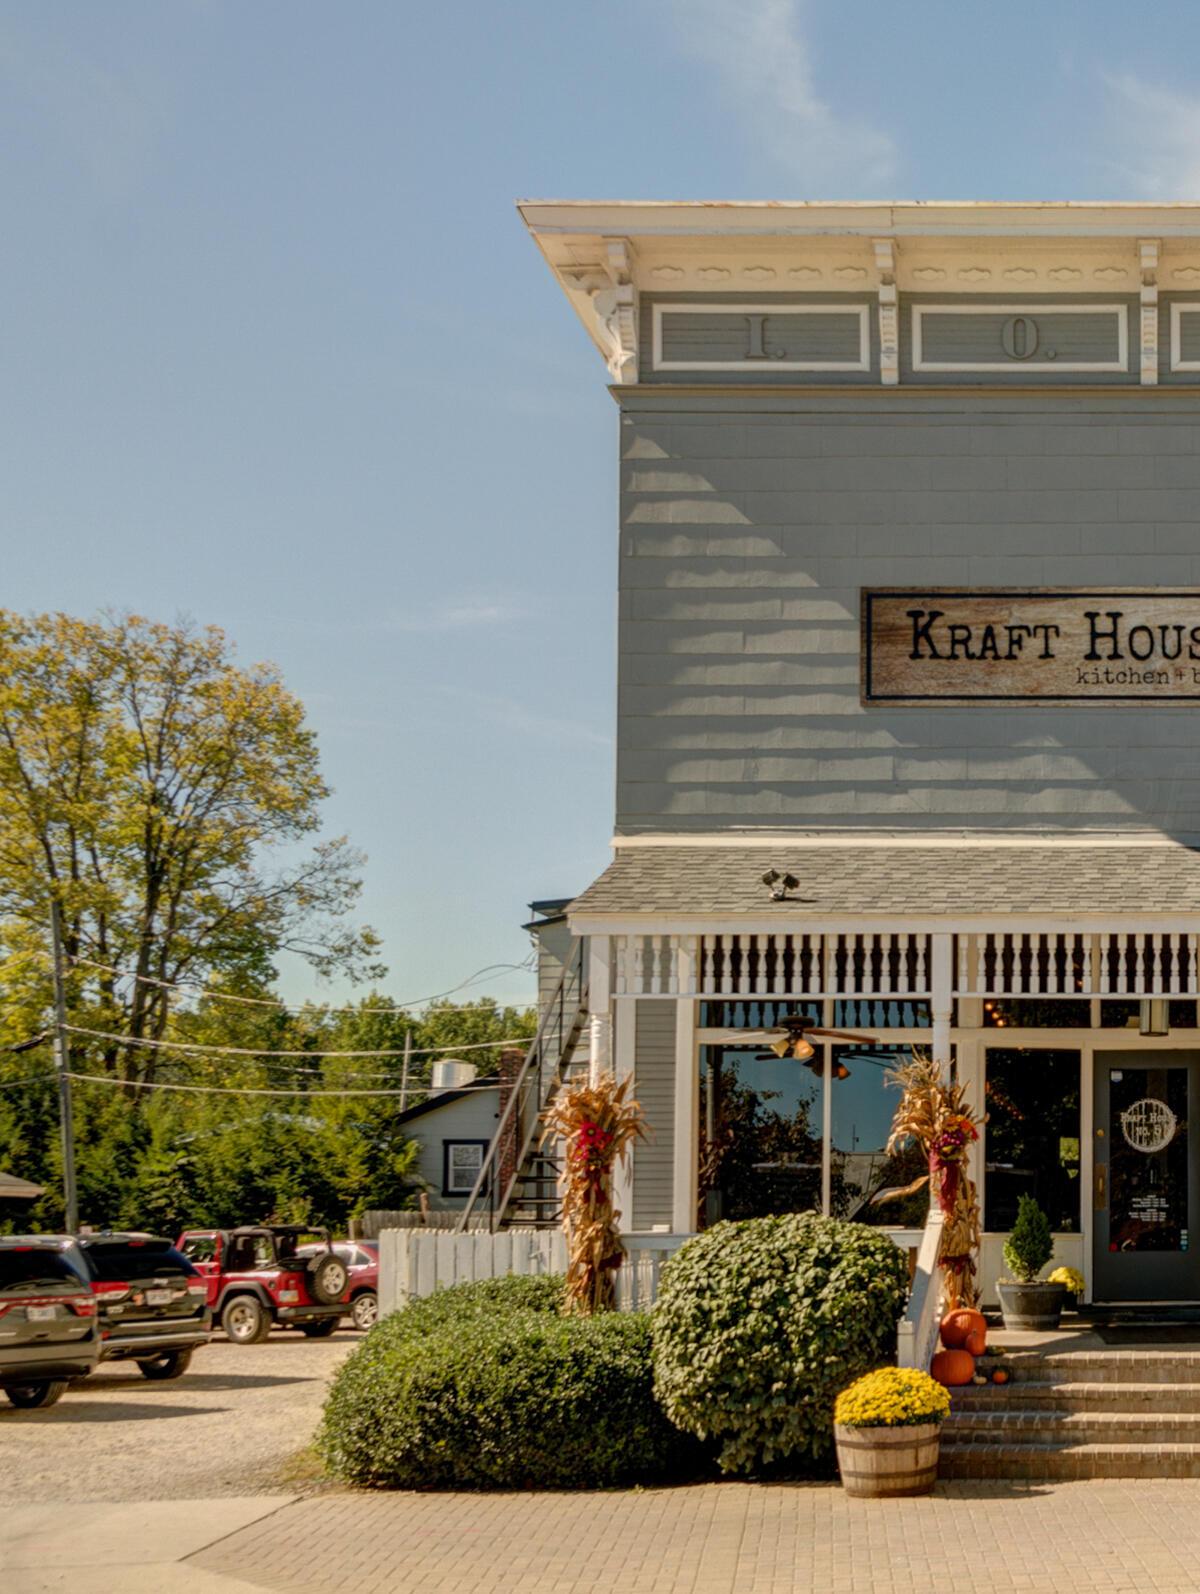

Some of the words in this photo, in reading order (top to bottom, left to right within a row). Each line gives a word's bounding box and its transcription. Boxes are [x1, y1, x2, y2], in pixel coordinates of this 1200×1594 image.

[744, 315, 787, 360] I.
[1002, 316, 1057, 360] O.
[905, 610, 1060, 662] KRAFT
[1076, 667, 1170, 685] kitchen
